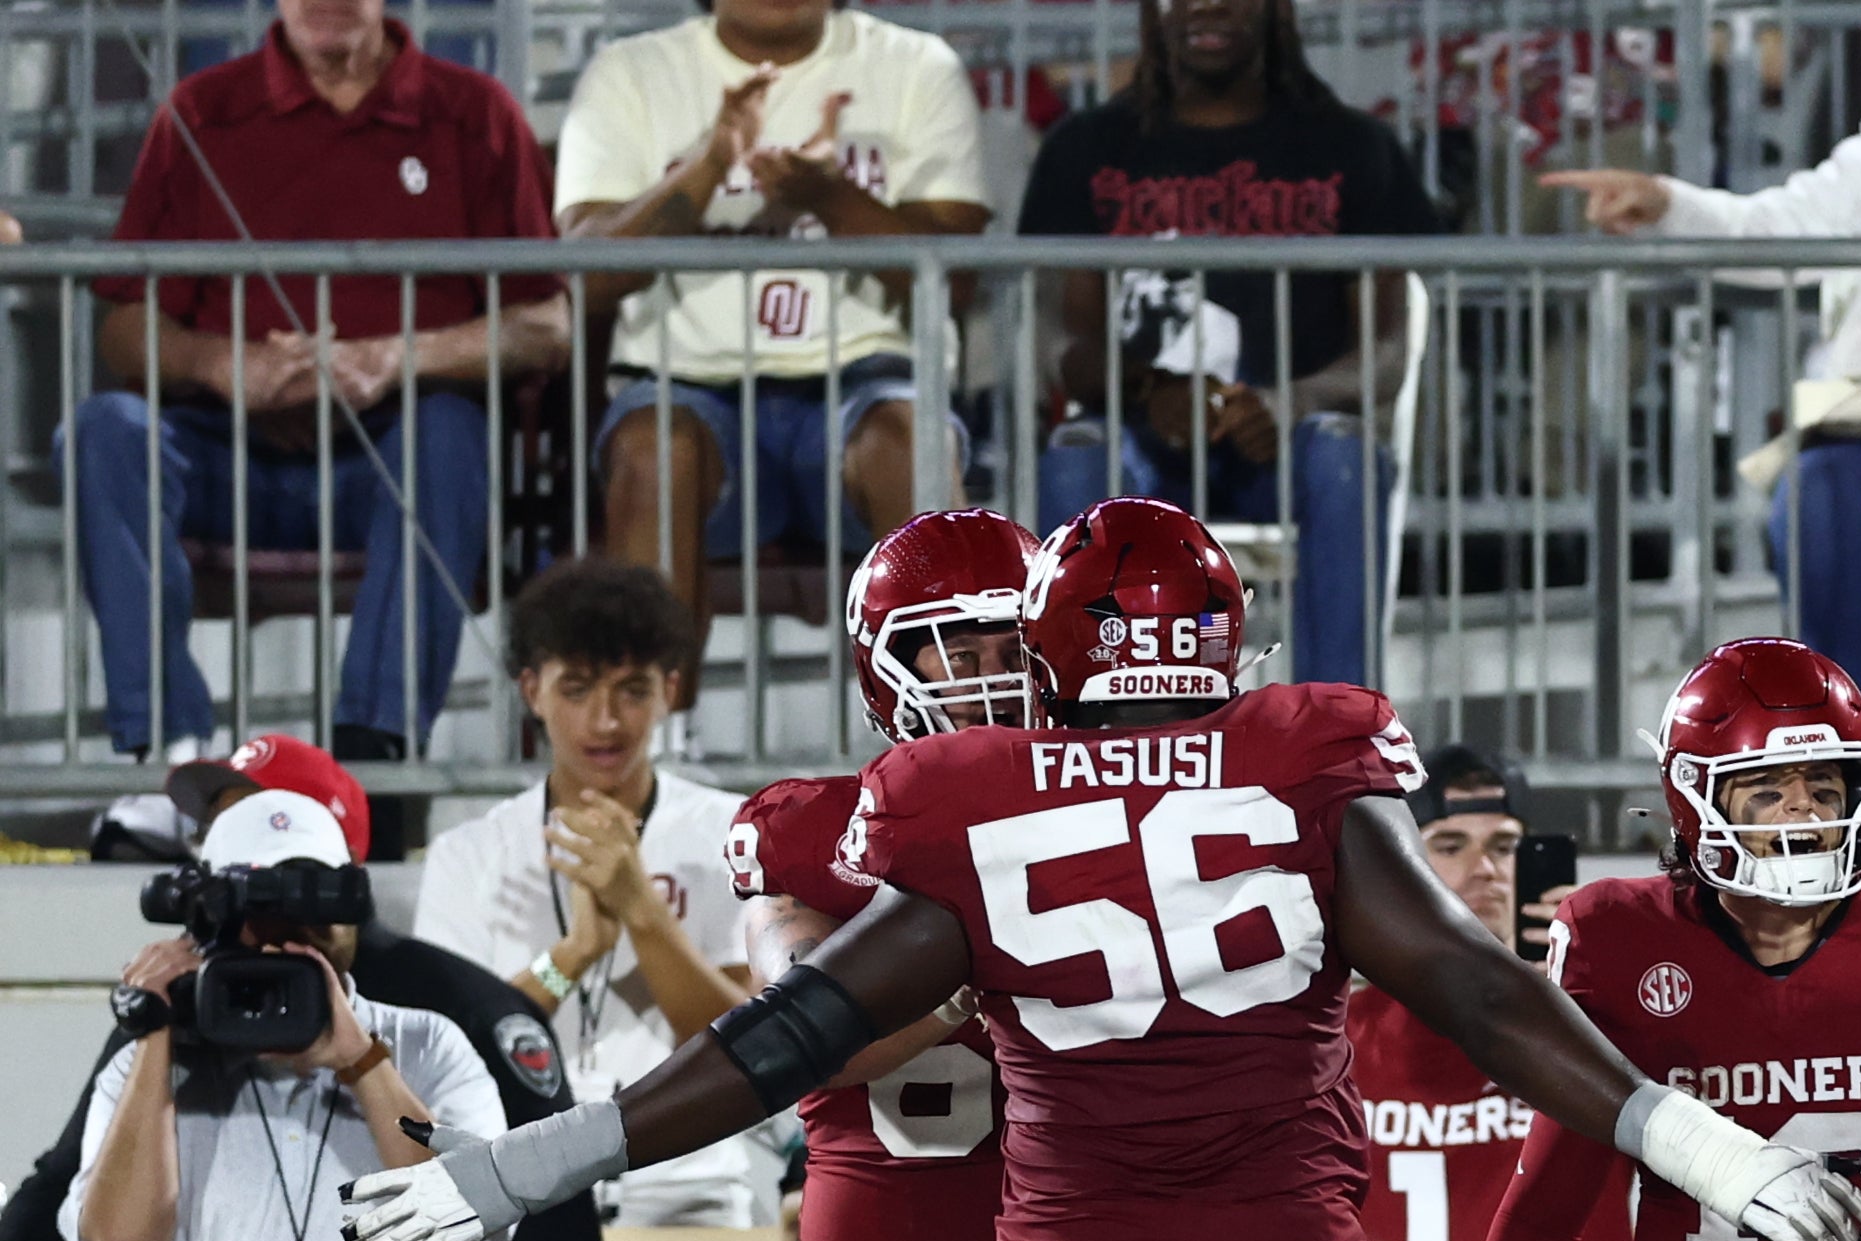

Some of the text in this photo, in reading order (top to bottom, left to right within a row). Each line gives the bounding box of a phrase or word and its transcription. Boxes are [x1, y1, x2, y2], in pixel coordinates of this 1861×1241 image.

[1101, 619, 1125, 644] SEC
[1131, 617, 1197, 660] 56
[1109, 675, 1214, 695] SOONERS
[1030, 730, 1223, 791] FASUSI
[1783, 732, 1828, 746] OKLAHOMA
[967, 785, 1326, 1052] 56
[1641, 966, 1690, 1014] SEC
